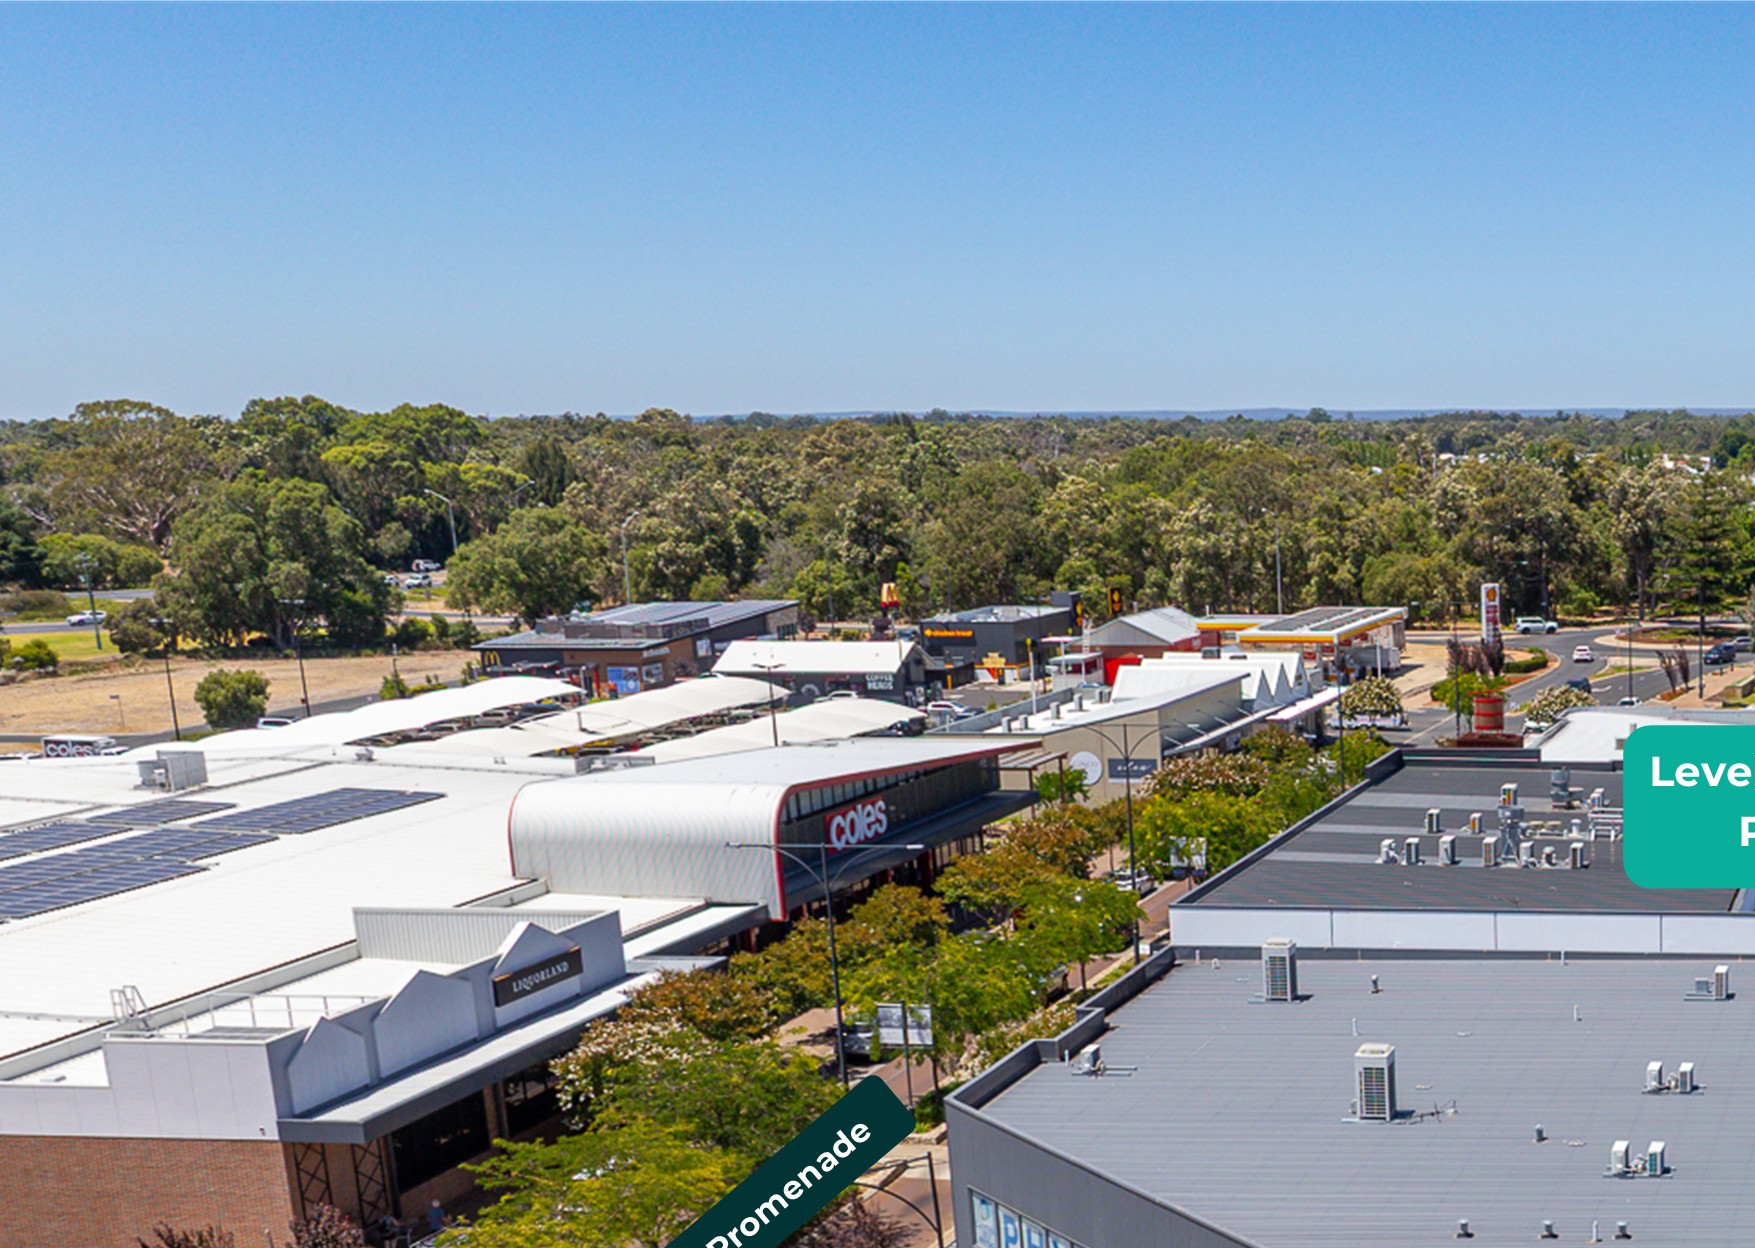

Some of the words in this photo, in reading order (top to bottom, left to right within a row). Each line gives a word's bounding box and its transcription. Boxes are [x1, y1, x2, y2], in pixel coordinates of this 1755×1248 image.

[46, 741, 94, 757] coles
[830, 800, 888, 851] coles
[512, 961, 570, 993] LIQUORLAND
